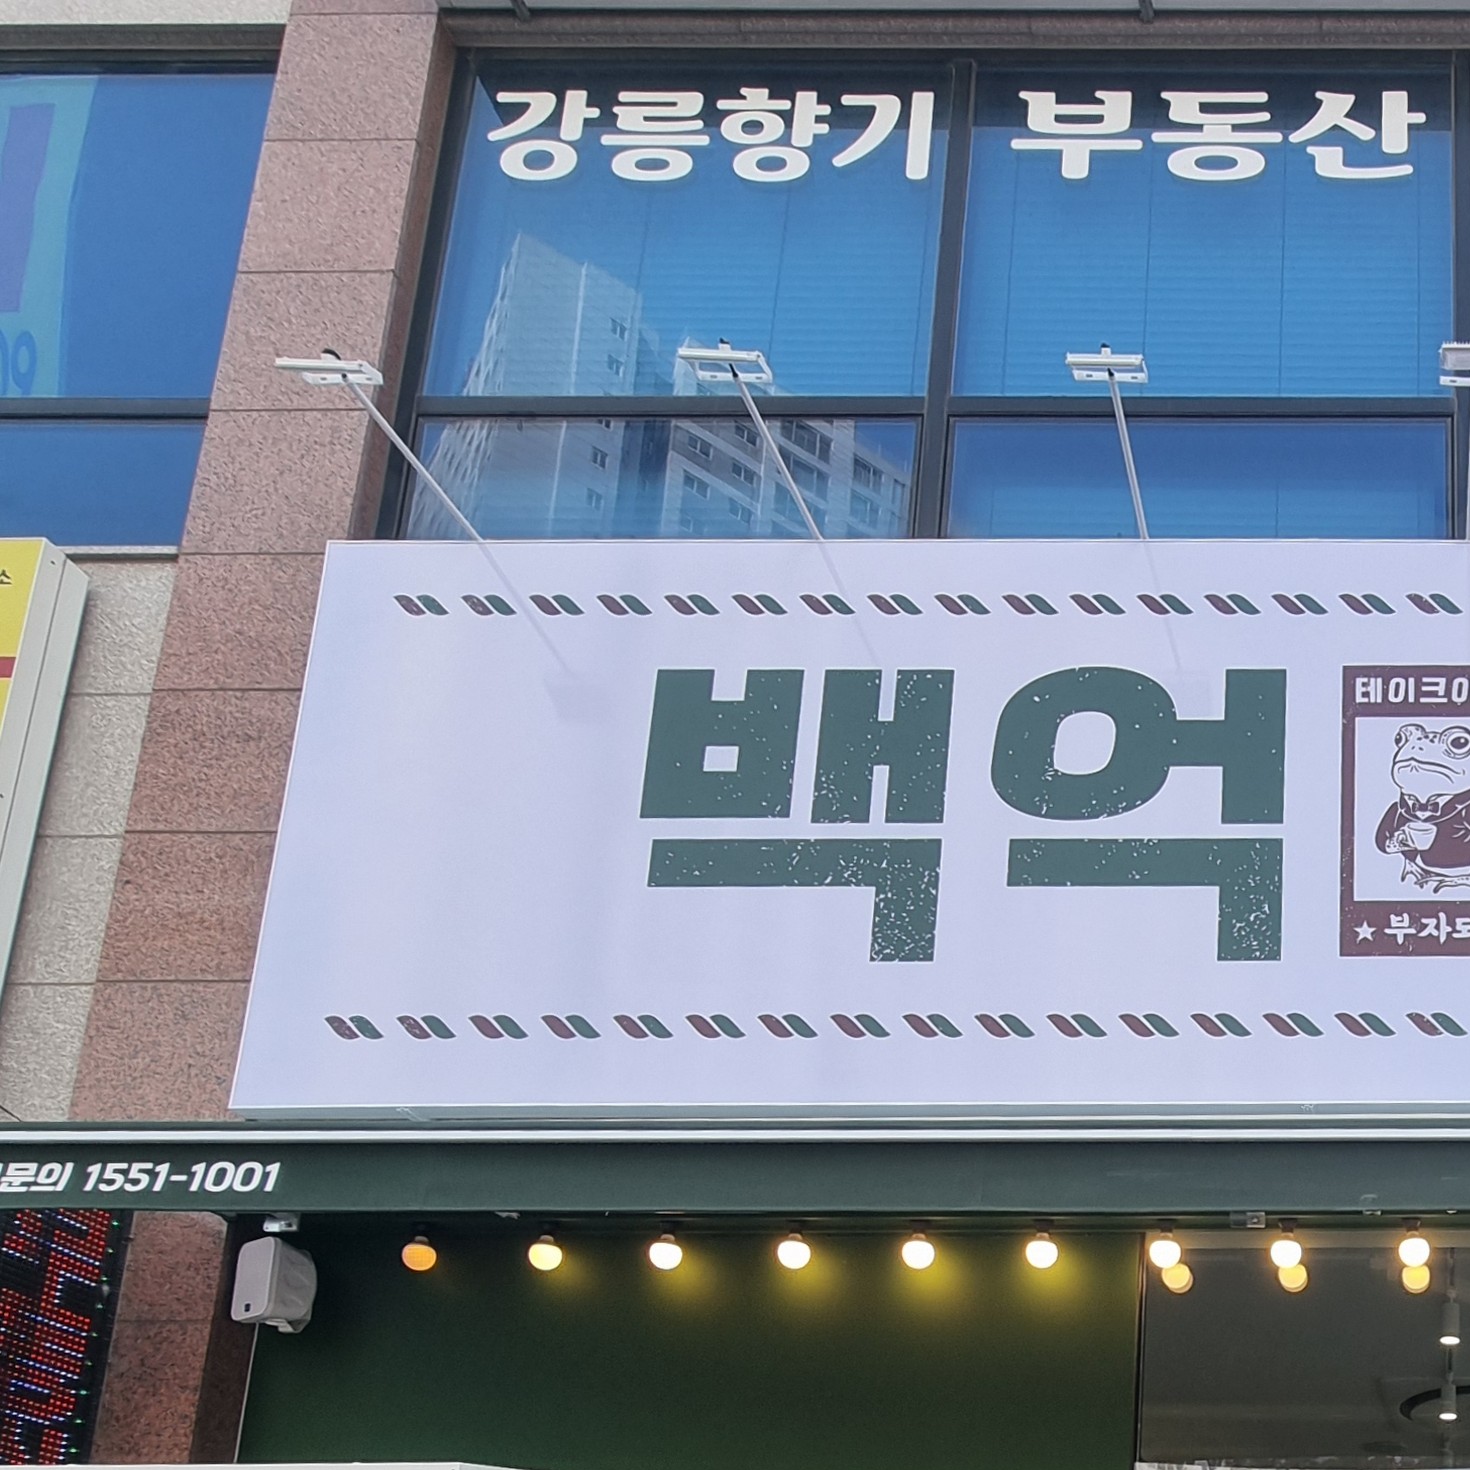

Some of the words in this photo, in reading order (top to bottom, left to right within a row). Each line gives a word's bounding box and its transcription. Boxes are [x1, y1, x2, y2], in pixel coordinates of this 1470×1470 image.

[486, 88, 932, 183] 강릉향기
[1010, 89, 1427, 183] 부동산
[639, 665, 1288, 963] 백억
[0, 1162, 74, 1192] 문의
[83, 1162, 281, 1192] 1551-1001
